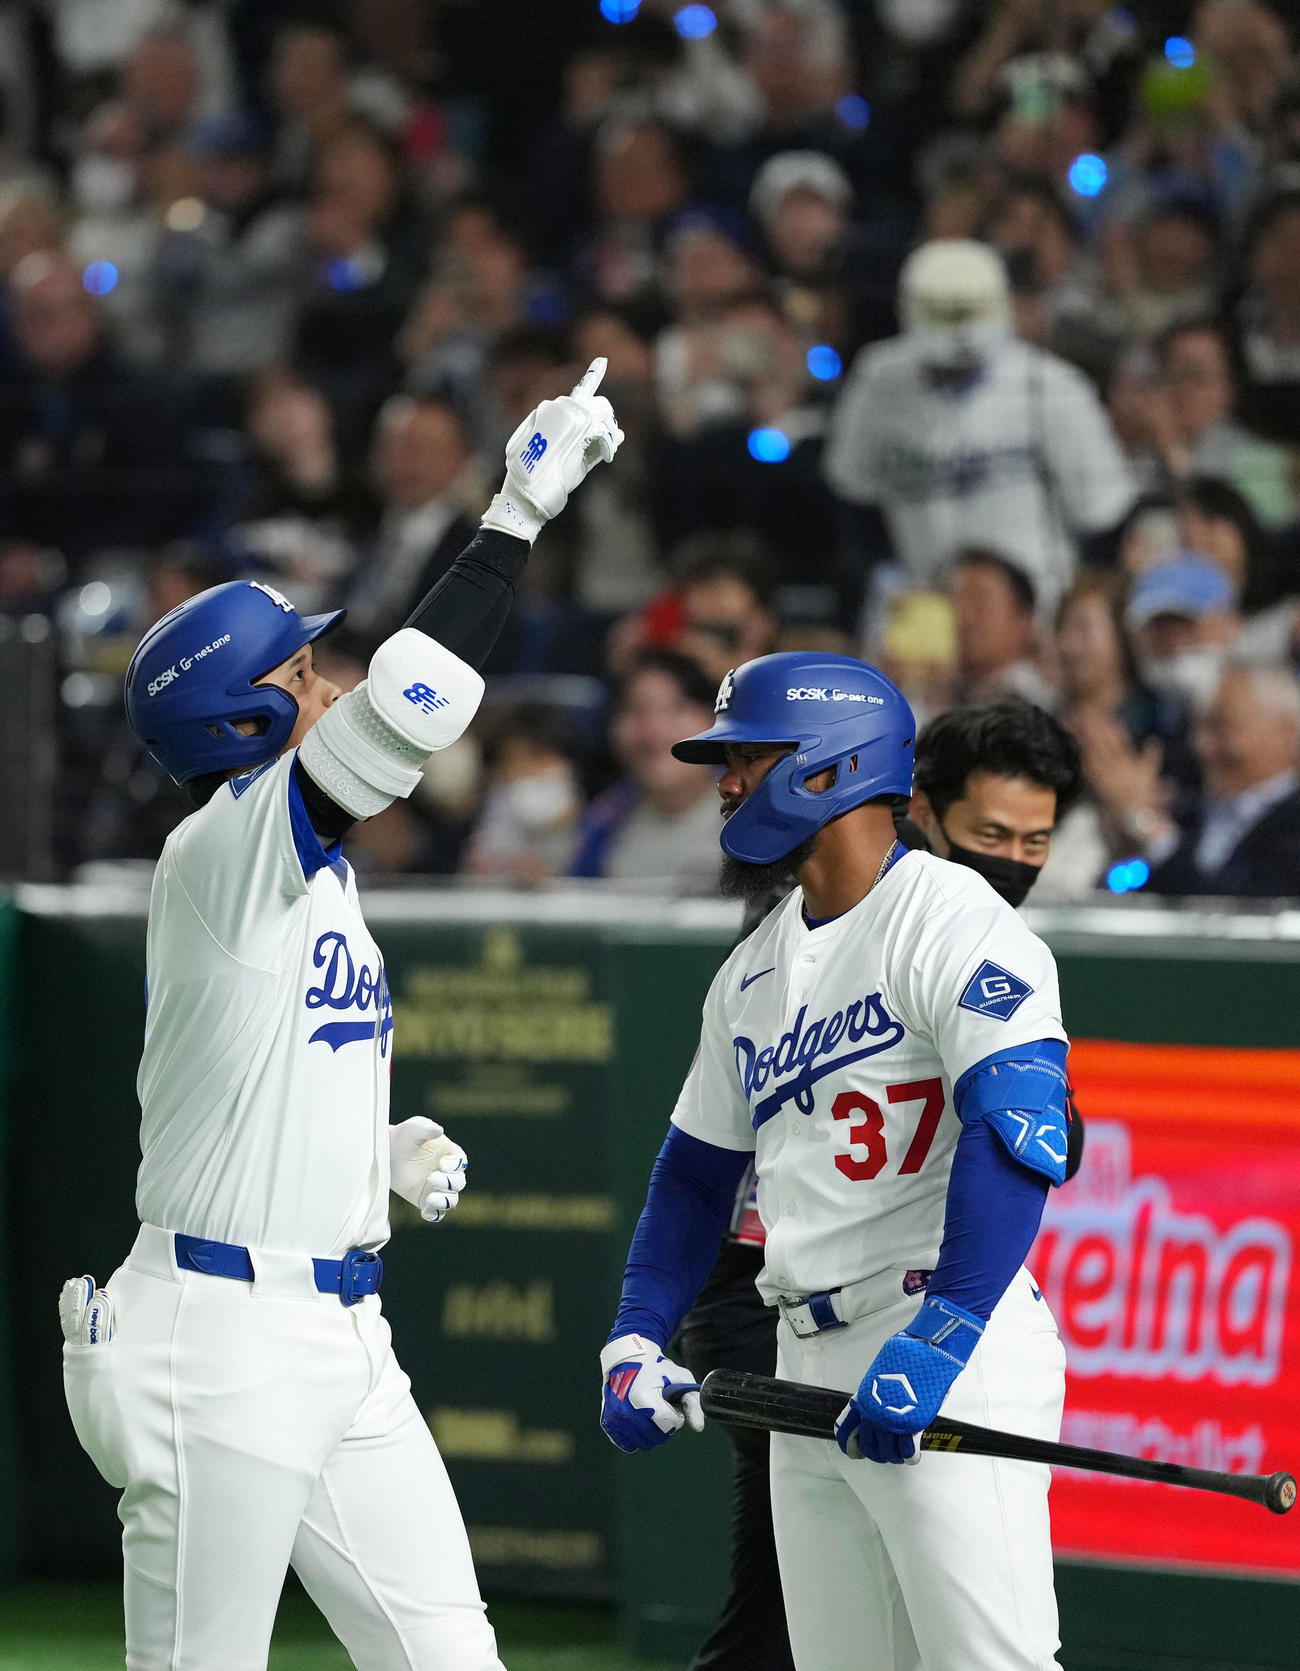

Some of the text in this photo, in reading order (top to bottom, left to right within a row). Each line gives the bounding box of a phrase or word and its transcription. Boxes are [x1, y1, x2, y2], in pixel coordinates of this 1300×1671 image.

[147, 665, 180, 697] SCSK
[786, 687, 829, 701] SCSK
[979, 994, 1021, 1009] GUGGENHEIM
[733, 991, 905, 1122] Dodgers
[831, 1077, 945, 1181] 37
